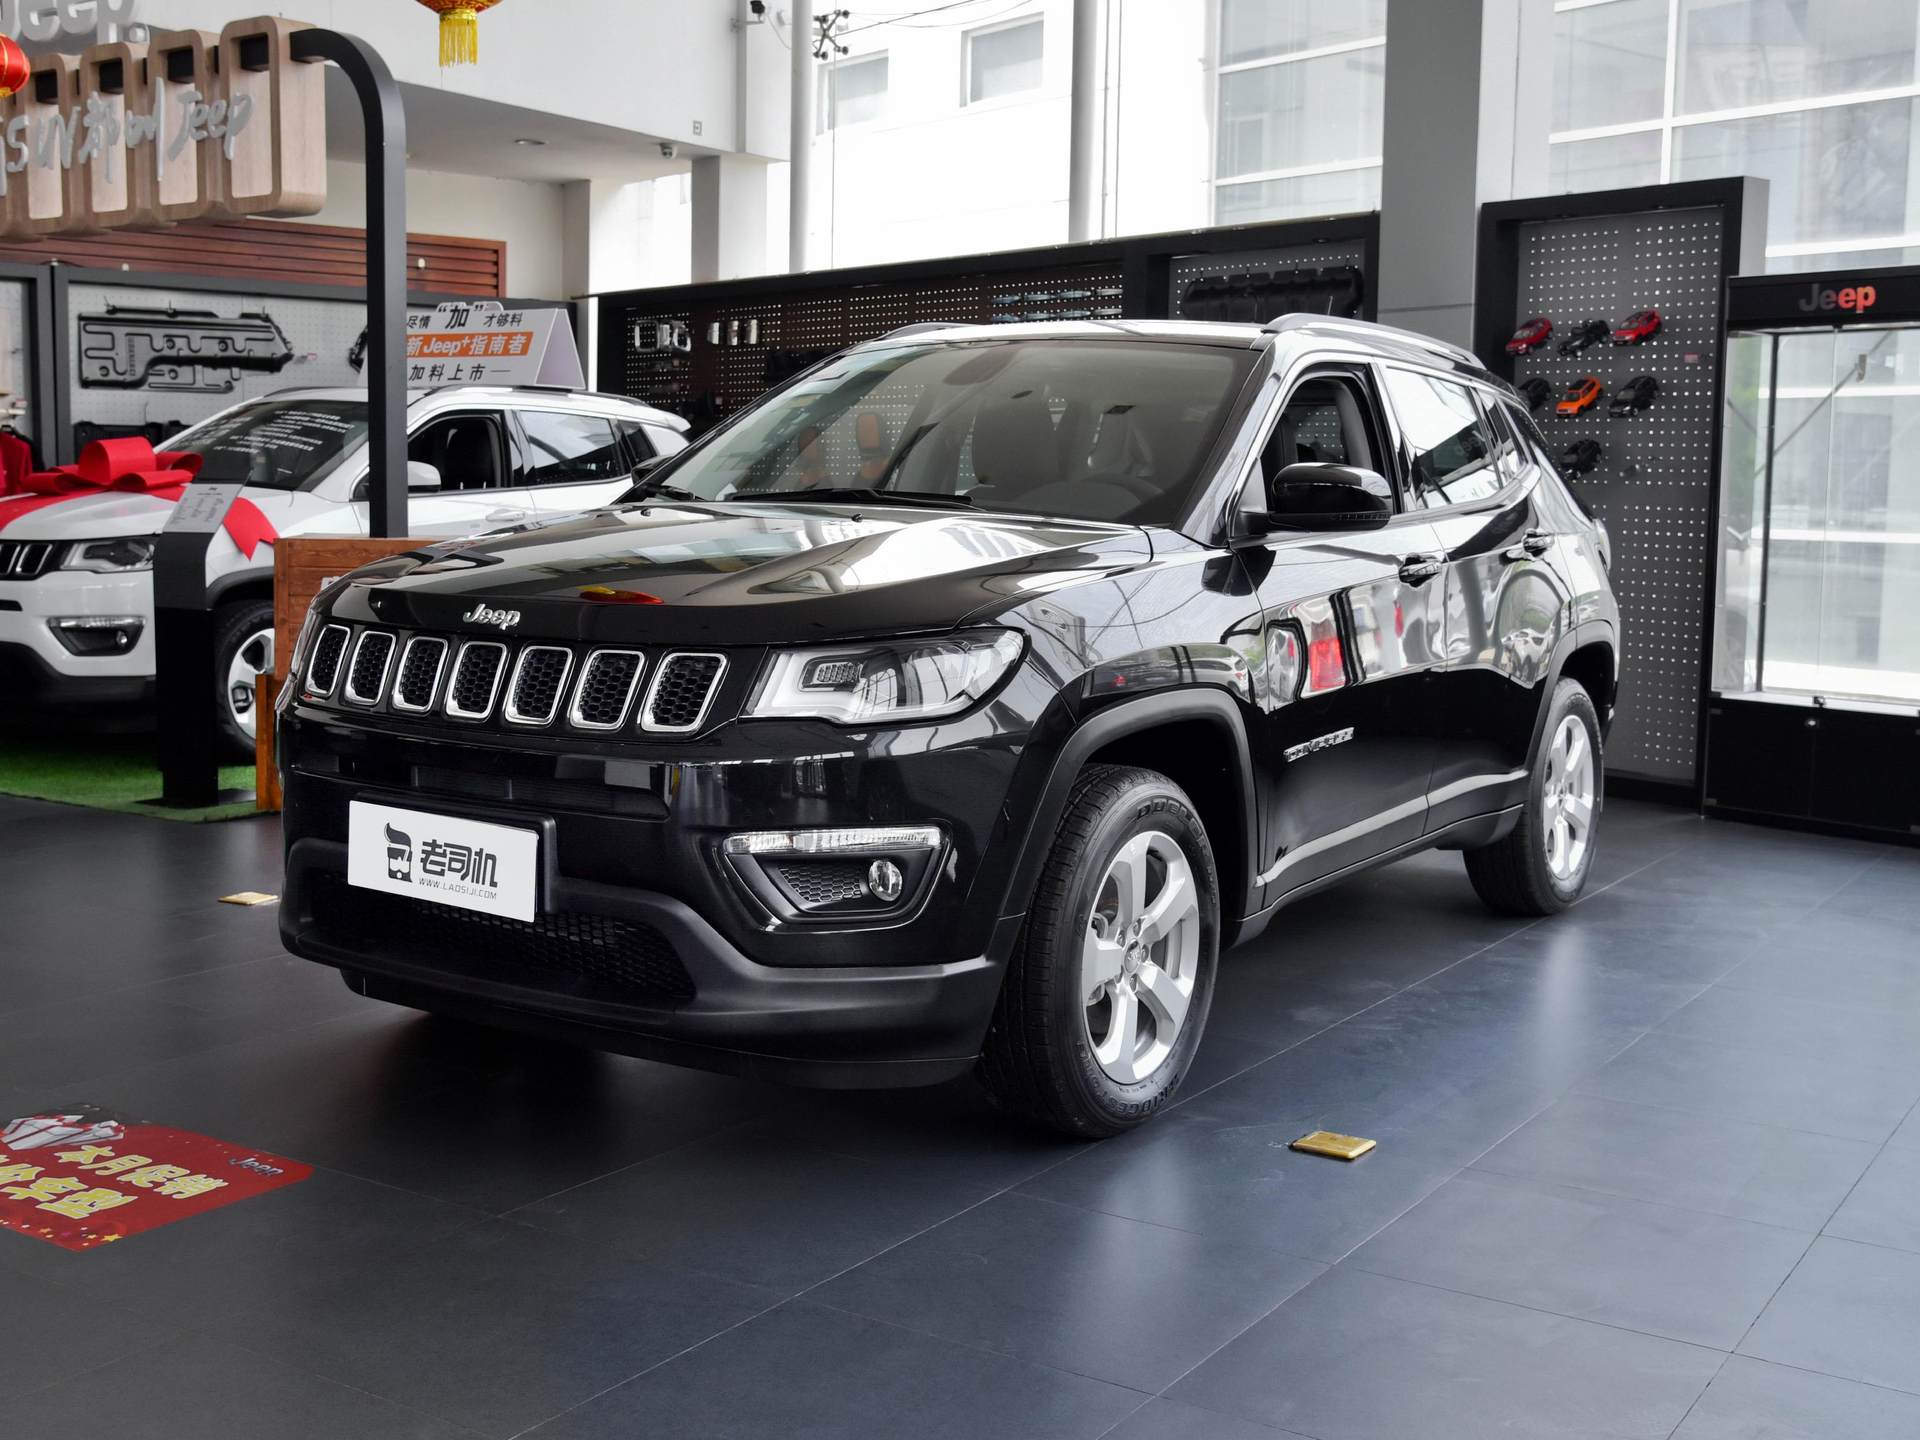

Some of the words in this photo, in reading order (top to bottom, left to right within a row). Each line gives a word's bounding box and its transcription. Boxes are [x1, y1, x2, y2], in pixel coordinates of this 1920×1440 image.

[1799, 283, 1877, 314] Jeep
[463, 603, 521, 630] Jeep
[420, 839, 498, 888] 老司机
[418, 877, 498, 901] WWW.LAOSIJI.COM
[54, 1145, 229, 1199] 本月促销
